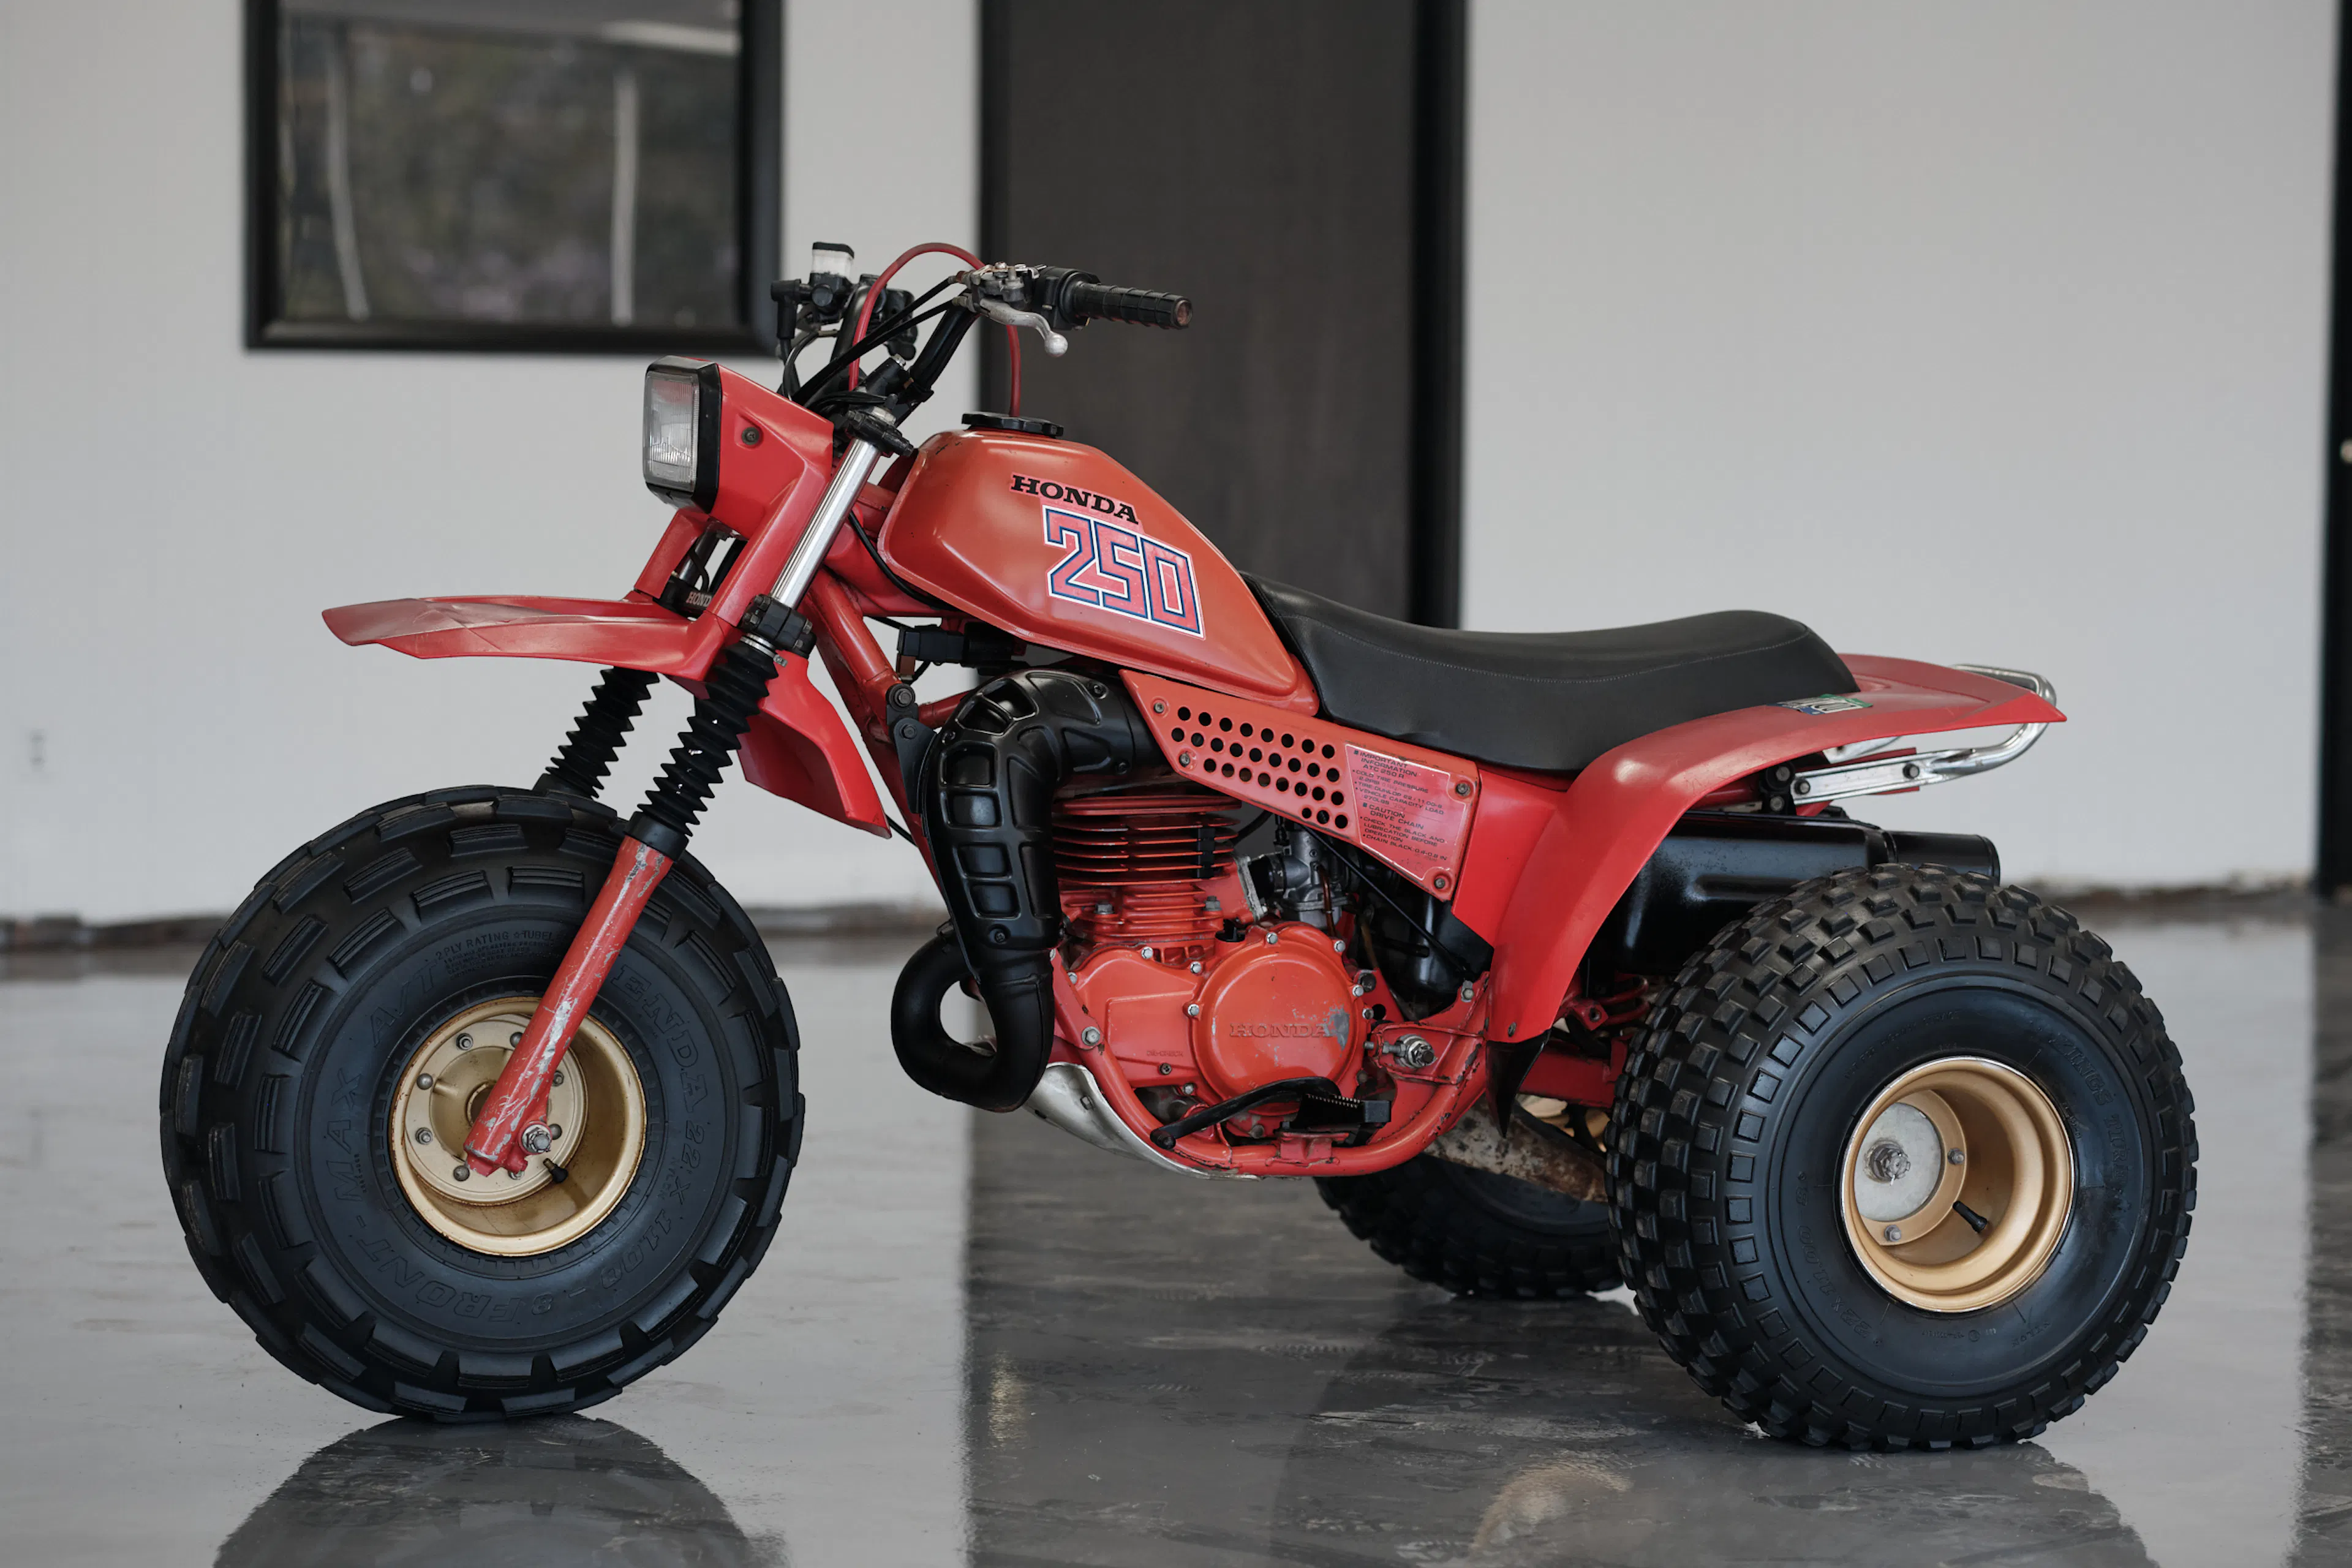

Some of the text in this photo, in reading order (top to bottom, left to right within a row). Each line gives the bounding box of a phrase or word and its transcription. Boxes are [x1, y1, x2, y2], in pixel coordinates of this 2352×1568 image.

[1011, 475, 1139, 525] HONDA
[1042, 504, 1205, 639] 250
[685, 591, 712, 608] HOND
[1360, 752, 1408, 768] IMPORTANT
[1361, 758, 1417, 777] INFORMATION
[1374, 786, 1402, 796] DUNLOP
[1393, 780, 1428, 793] PRESSURE
[1359, 788, 1387, 798] VEHICLE
[1389, 796, 1423, 809] CAPACITY
[1369, 805, 1405, 818] CAUTION
[1370, 811, 1424, 829] DRIVE CHAIN
[1363, 817, 1385, 826] CHECK
[1364, 823, 1438, 846] LUBRICATION BEFORE
[1365, 829, 1403, 842] OPERATION
[1366, 835, 1388, 845] CHAIN
[443, 943, 462, 957] PLY
[466, 931, 510, 948] RATING
[610, 963, 708, 1113] ENDA
[1229, 1023, 1334, 1038] HONDA
[334, 1068, 363, 1202] MAX
[682, 1120, 704, 1169] 22
[356, 1239, 522, 1322] FRONT
[532, 1294, 554, 1315] 8
